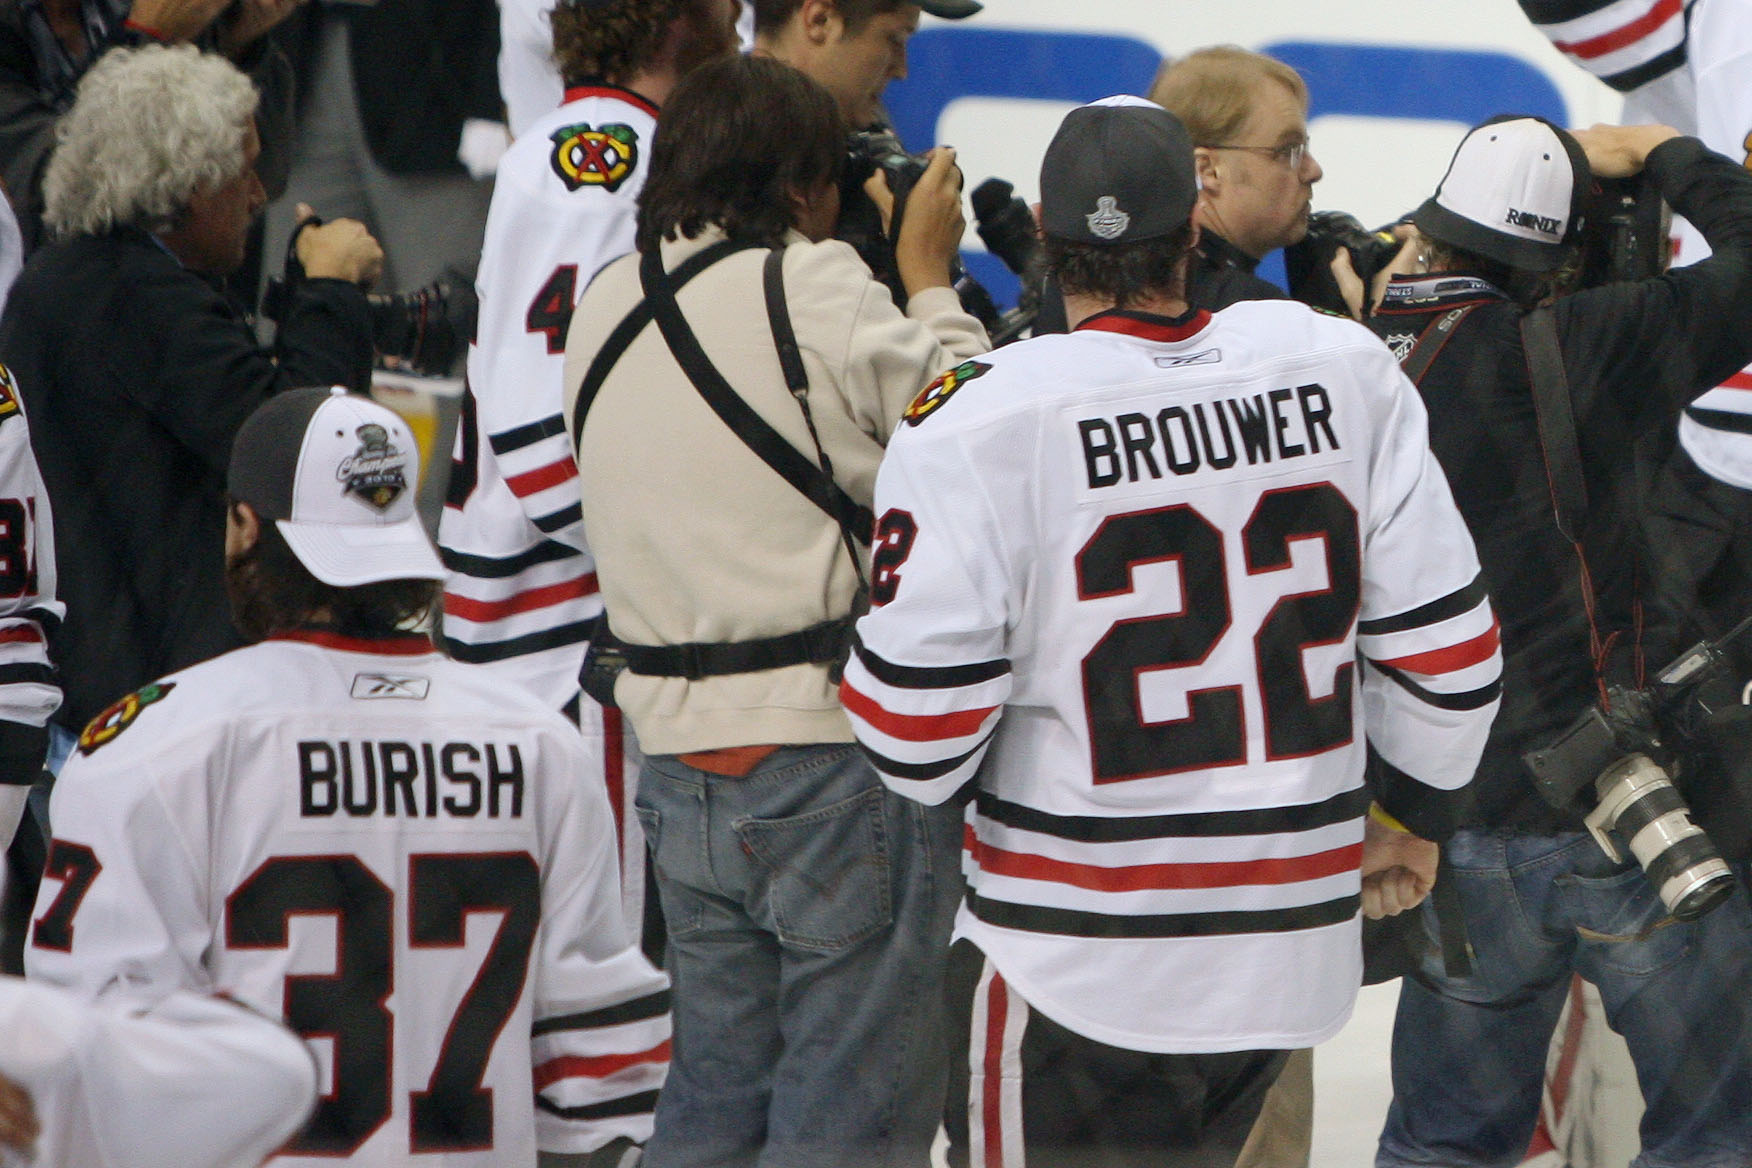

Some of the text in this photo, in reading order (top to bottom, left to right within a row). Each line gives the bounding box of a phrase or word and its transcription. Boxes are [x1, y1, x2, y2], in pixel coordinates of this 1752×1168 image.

[1078, 383, 1341, 490] BROUWER
[1075, 480, 1364, 786] 22
[297, 740, 524, 819] BURISH
[225, 850, 541, 1158] 37
